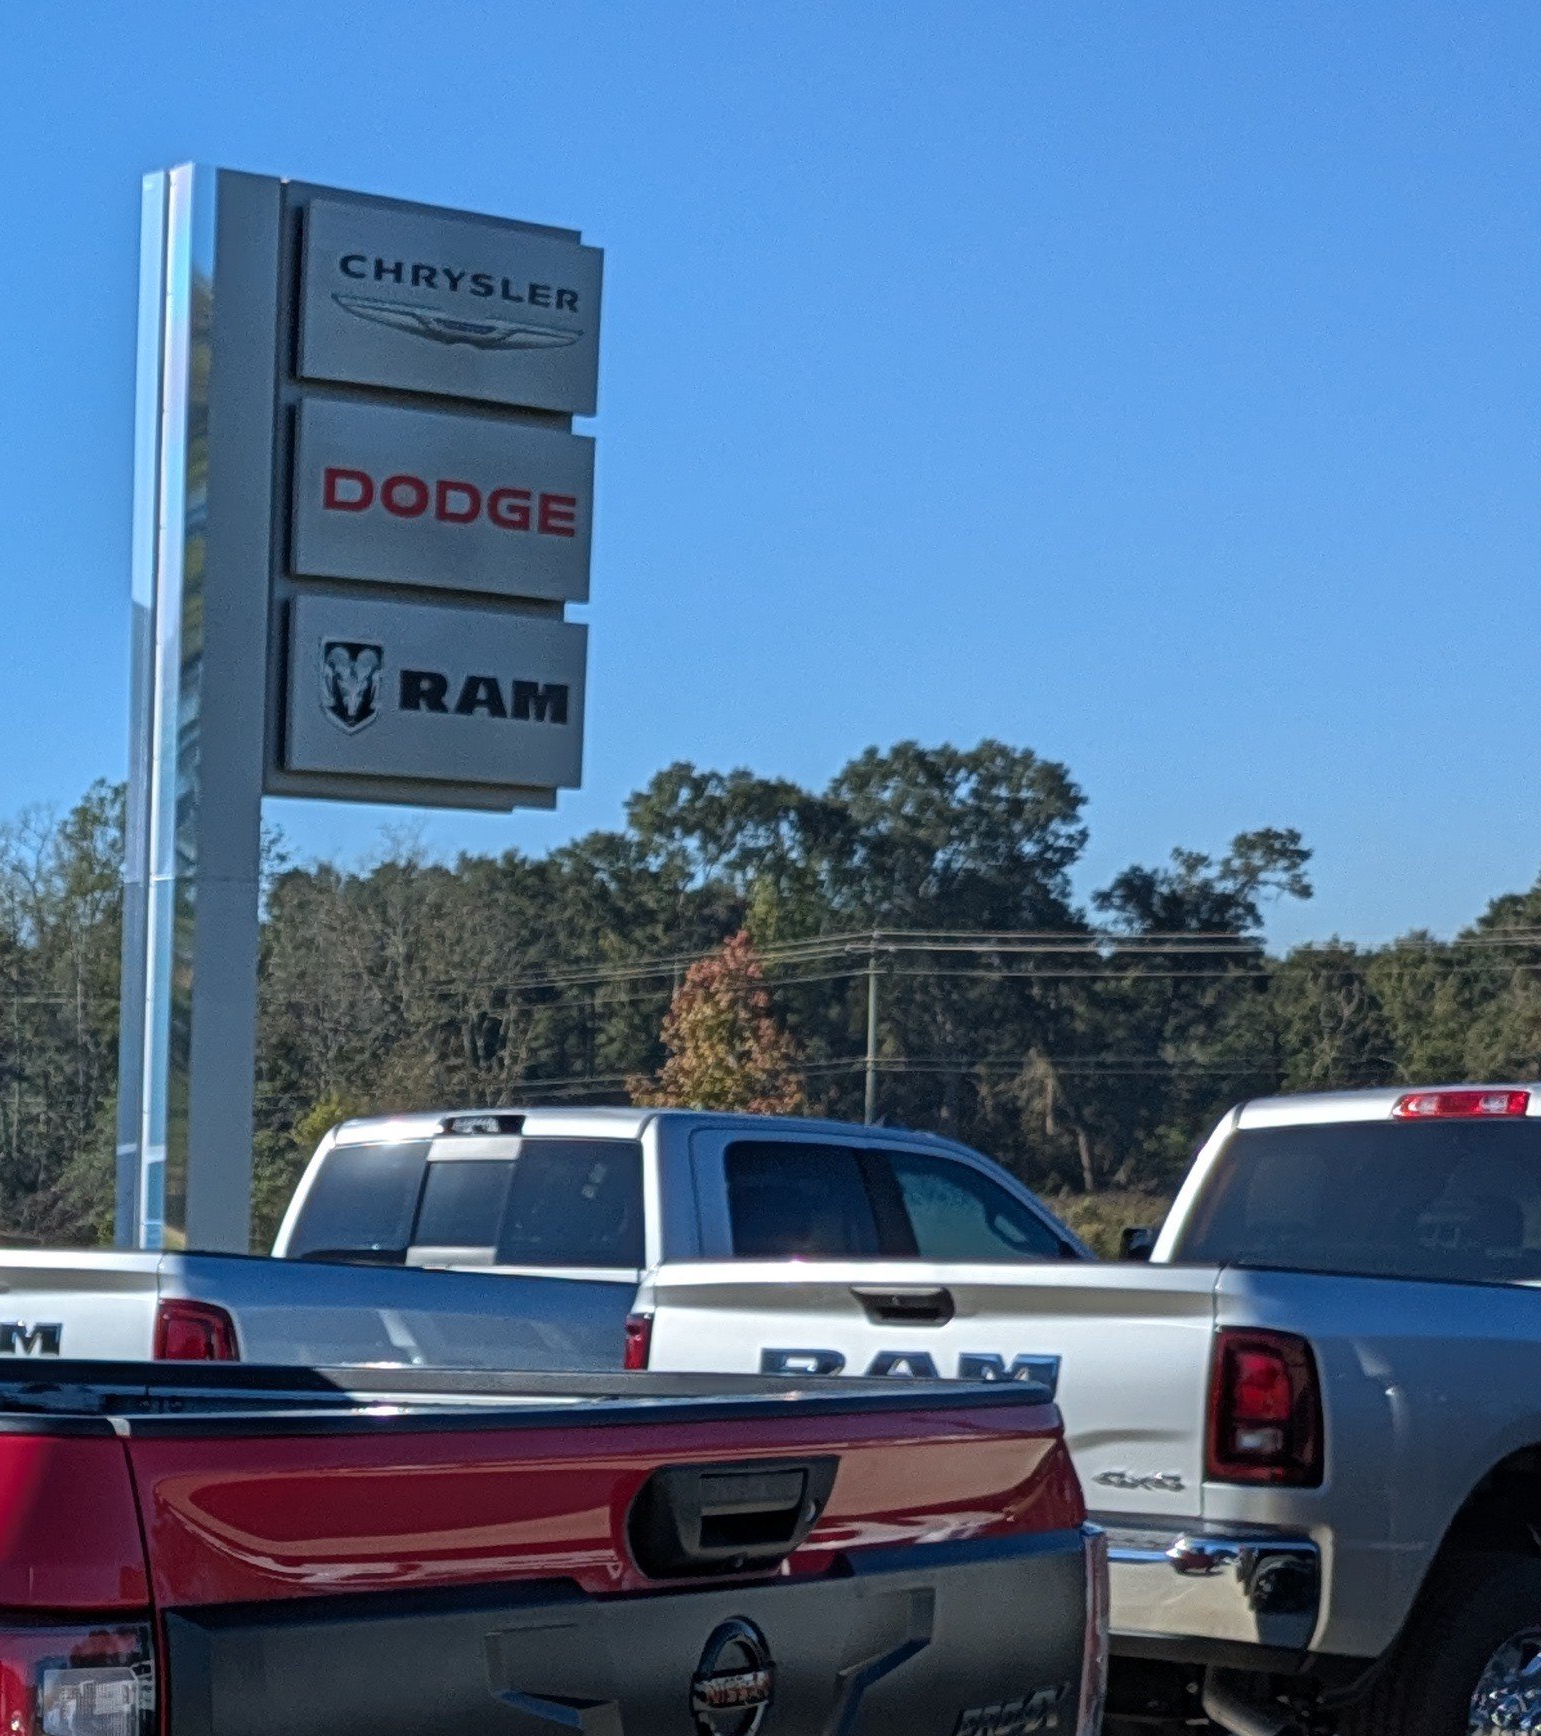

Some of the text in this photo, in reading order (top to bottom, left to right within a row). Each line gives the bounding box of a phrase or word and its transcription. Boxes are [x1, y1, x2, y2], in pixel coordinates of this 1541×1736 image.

[339, 253, 580, 314] CHRYSLER
[322, 466, 577, 538] DODGE
[397, 668, 571, 725] RAM
